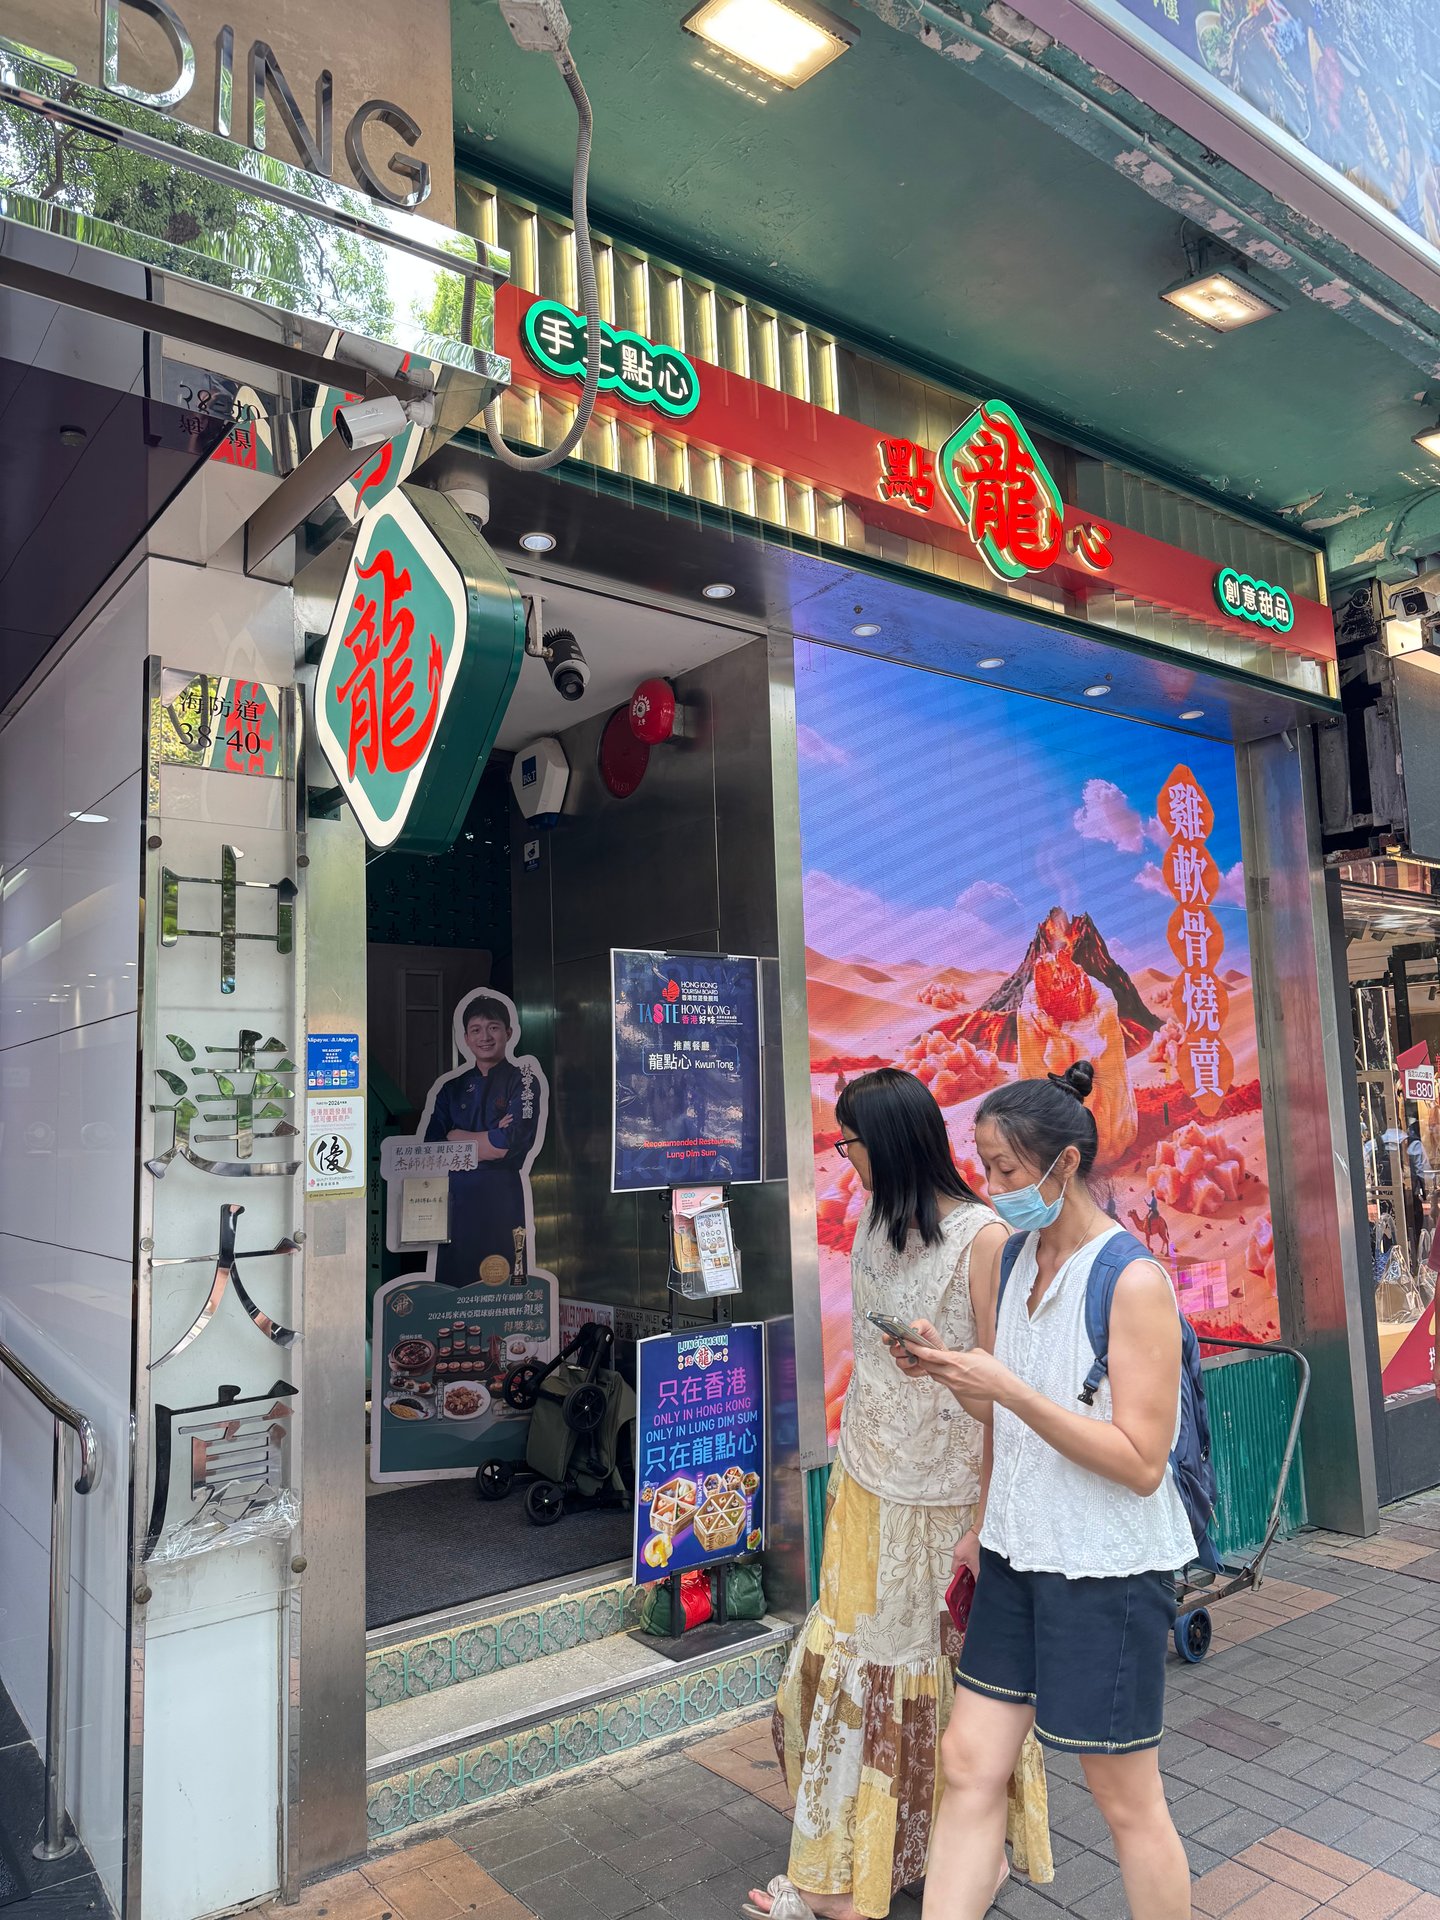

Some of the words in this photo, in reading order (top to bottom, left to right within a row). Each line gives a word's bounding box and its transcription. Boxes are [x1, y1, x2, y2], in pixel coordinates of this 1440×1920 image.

[0, 0, 432, 208] DING
[1224, 578, 1289, 623] 創意甜品
[336, 549, 444, 785] 龍
[179, 691, 260, 722] 海防道
[179, 722, 261, 754] 38-40
[1167, 782, 1224, 1099] 雞軟骨燒賣
[681, 981, 699, 989] HONG
[637, 1003, 680, 1024] TASTE
[681, 1004, 706, 1015] HONG
[707, 1005, 731, 1015] KONG
[681, 1015, 716, 1025] 香港好味
[673, 1041, 710, 1051] 推薦餐廳
[648, 1053, 692, 1070] 龍點心
[695, 1060, 715, 1069] Kwun
[716, 1060, 734, 1071] Tong
[1416, 1082, 1433, 1097] 880
[644, 1137, 698, 1148] Recommended
[666, 1150, 685, 1160] Lung
[686, 1149, 700, 1158] Dim
[701, 1149, 717, 1157] Sum
[657, 1366, 746, 1409] 只在香港
[646, 1427, 673, 1443] ONLY
[676, 1424, 686, 1437] IN
[689, 1419, 715, 1434] LUNG
[717, 1414, 735, 1429] DIM
[737, 1410, 758, 1424] SUM
[653, 1410, 680, 1427] ONLY
[683, 1408, 693, 1421] IN
[696, 1403, 723, 1415] HONG
[725, 1397, 751, 1412] KONG
[645, 1428, 758, 1477] 只在龍點心
